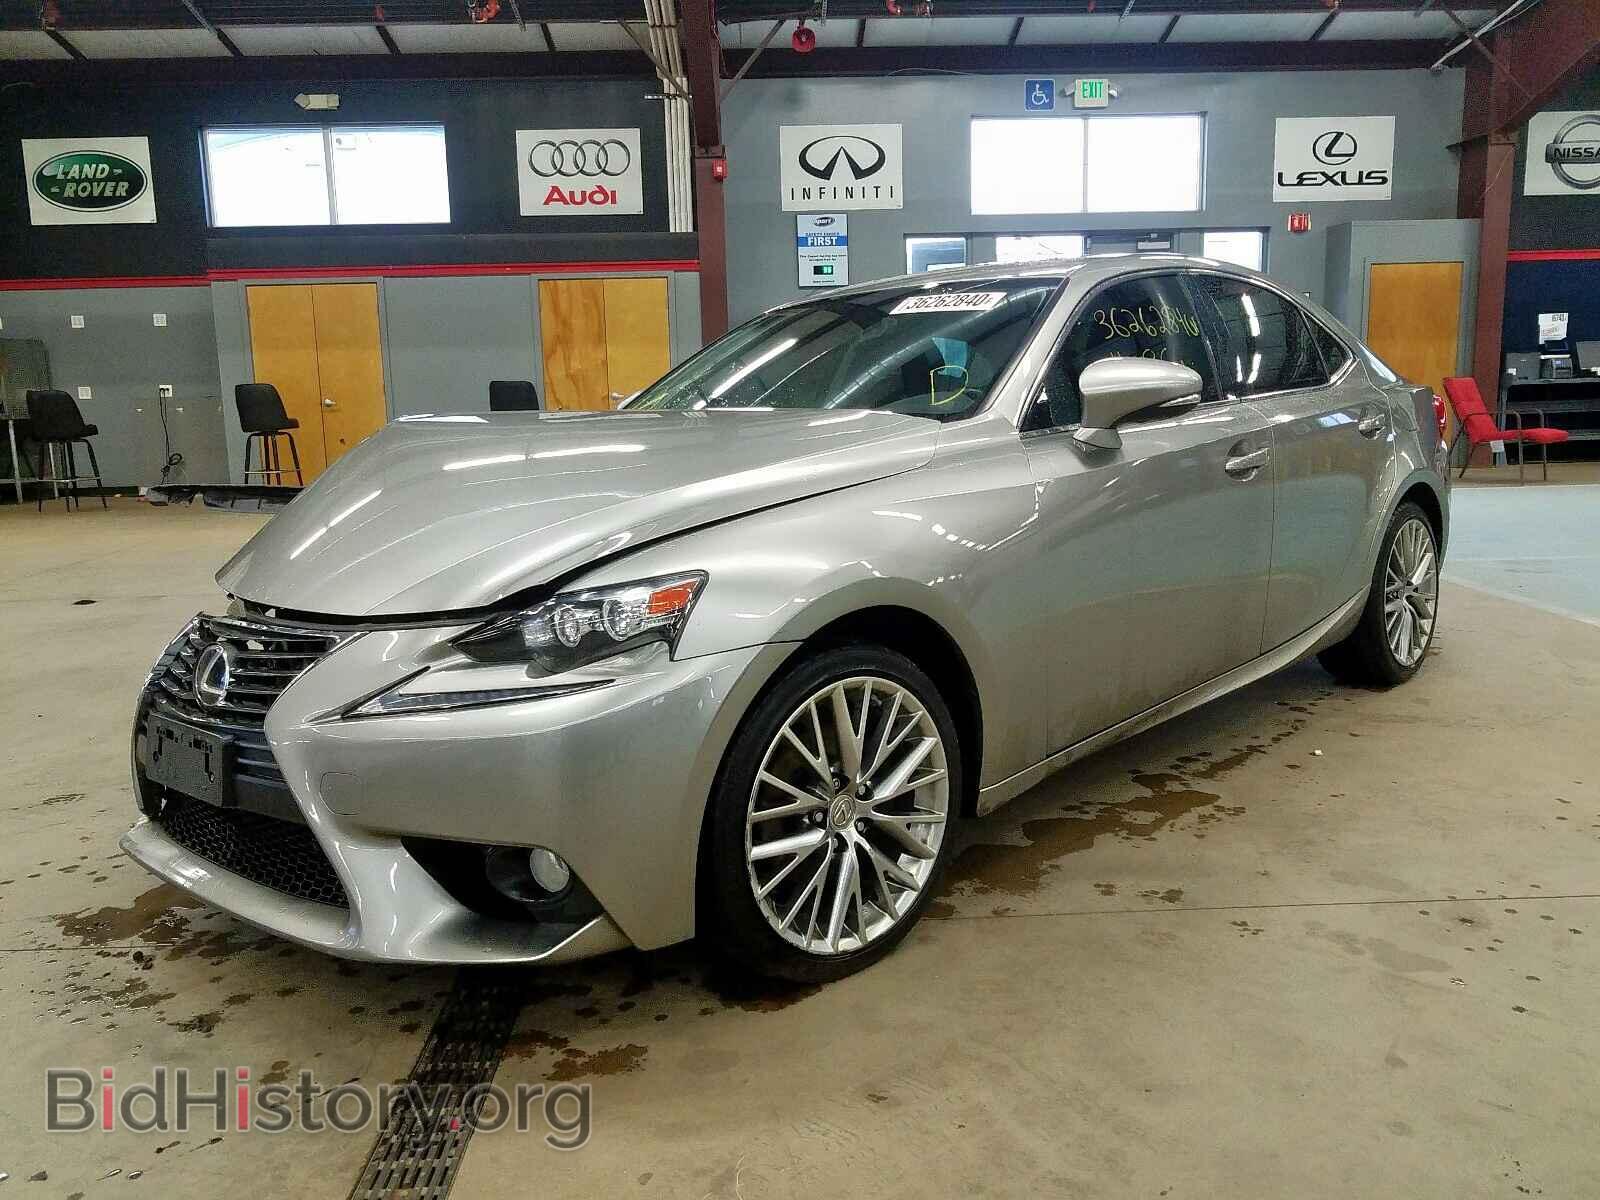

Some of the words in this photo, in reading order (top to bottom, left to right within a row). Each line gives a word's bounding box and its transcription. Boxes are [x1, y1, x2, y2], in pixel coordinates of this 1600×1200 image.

[1082, 81, 1103, 98] EXIT
[56, 164, 110, 179] LAND
[1278, 171, 1388, 186] LEXUS
[63, 181, 129, 197] ROVER
[543, 185, 617, 205] Audi
[791, 185, 894, 200] INFINITI
[807, 236, 838, 247] FIRST
